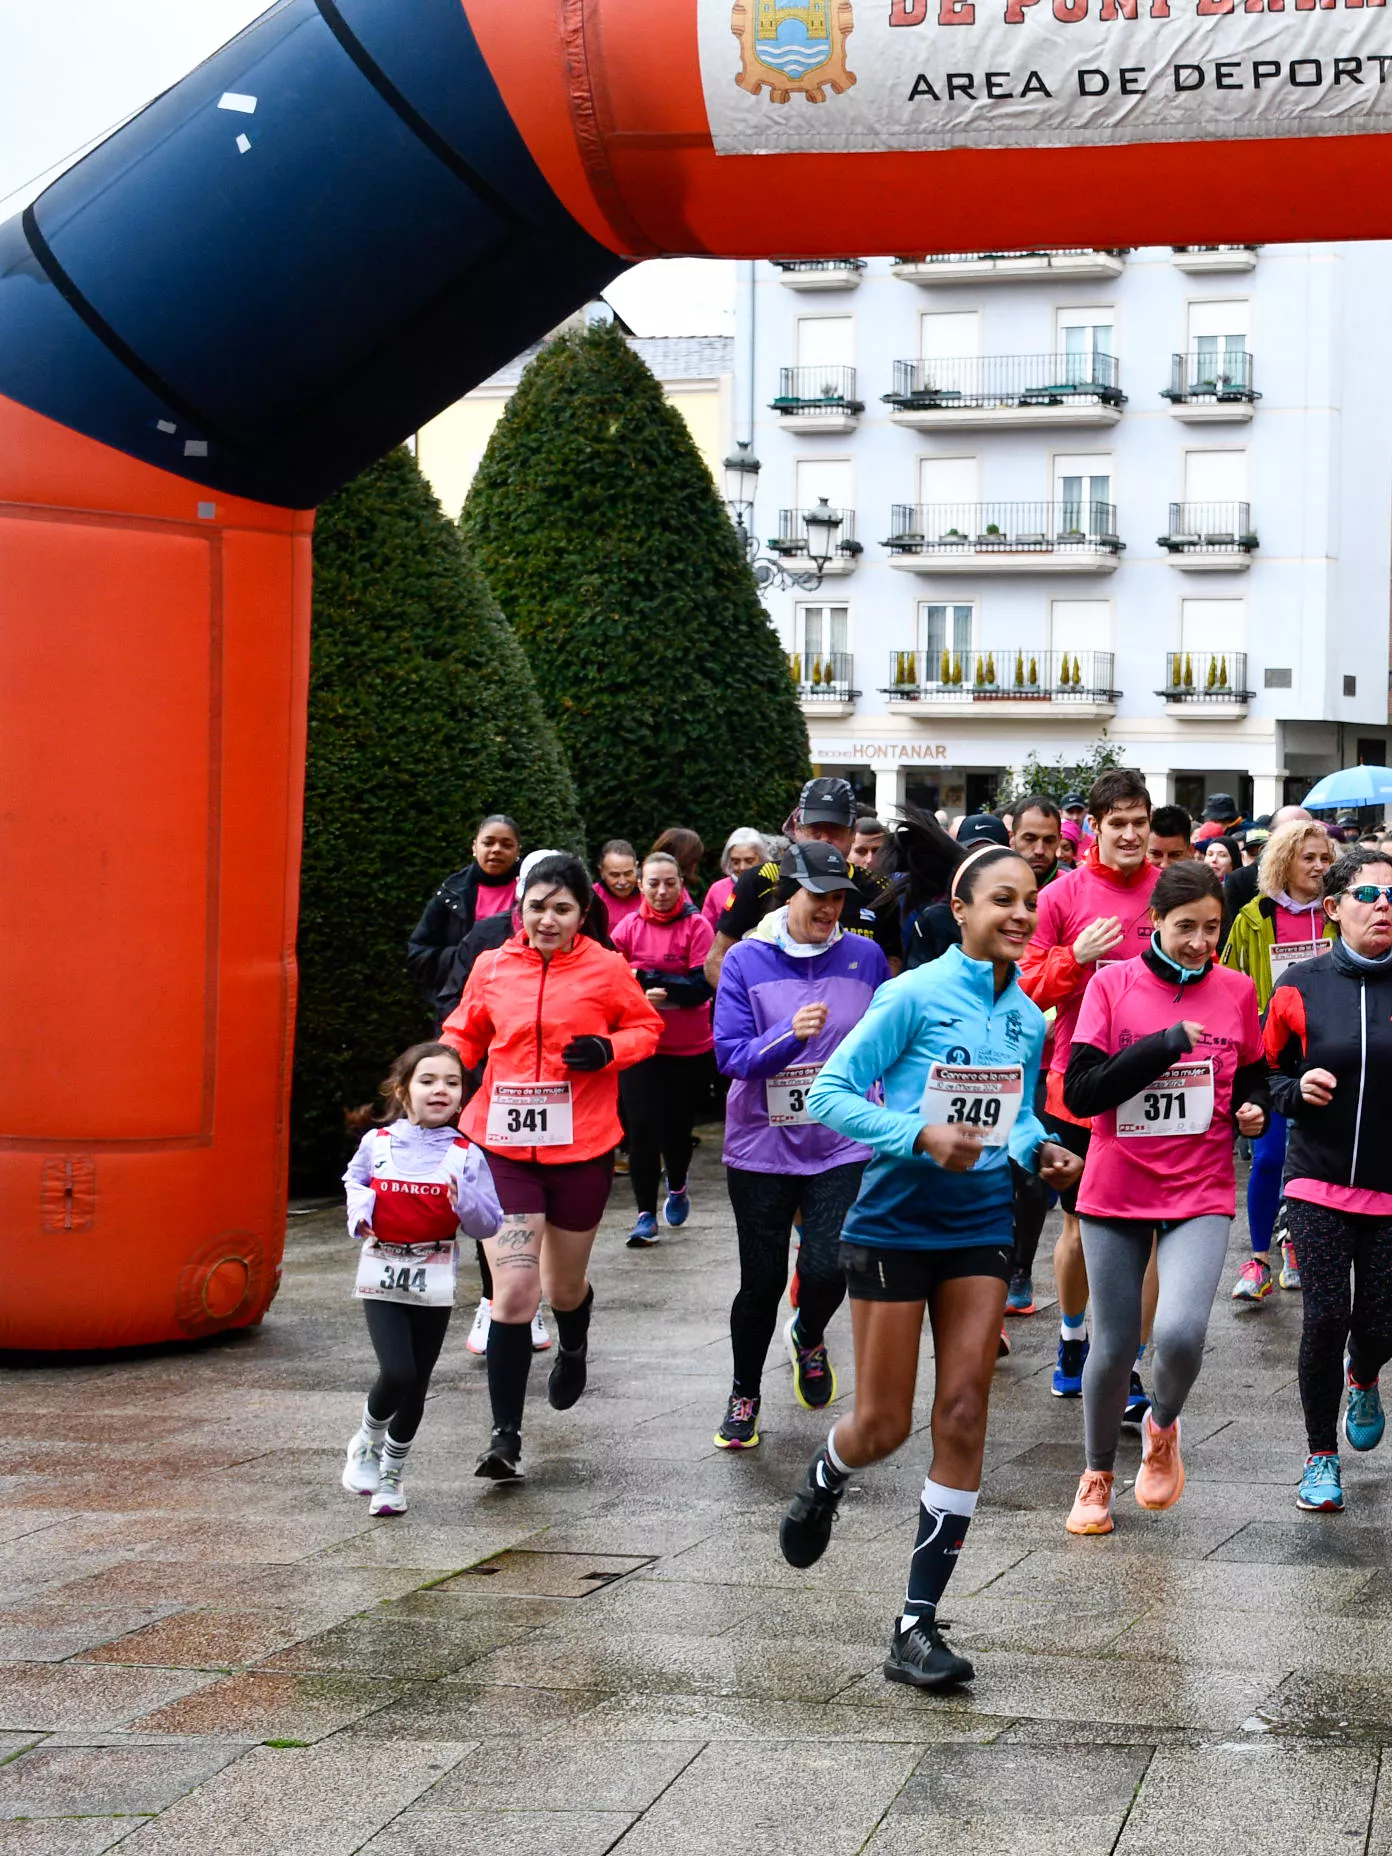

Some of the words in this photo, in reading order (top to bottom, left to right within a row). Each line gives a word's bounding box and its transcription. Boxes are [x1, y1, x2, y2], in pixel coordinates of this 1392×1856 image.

[908, 71, 1053, 101] AREA
[1078, 67, 1147, 97] DE
[853, 744, 947, 759] HONTANAR
[940, 1070, 977, 1080] Carrera
[978, 1072, 989, 1080] de
[989, 1072, 998, 1080] la
[1180, 1068, 1206, 1077] mujer
[947, 1097, 1001, 1127] 349
[1144, 1092, 1186, 1121] 371
[507, 1108, 548, 1132] 341
[391, 1182, 441, 1195] BARCO
[380, 1265, 427, 1292] 344
